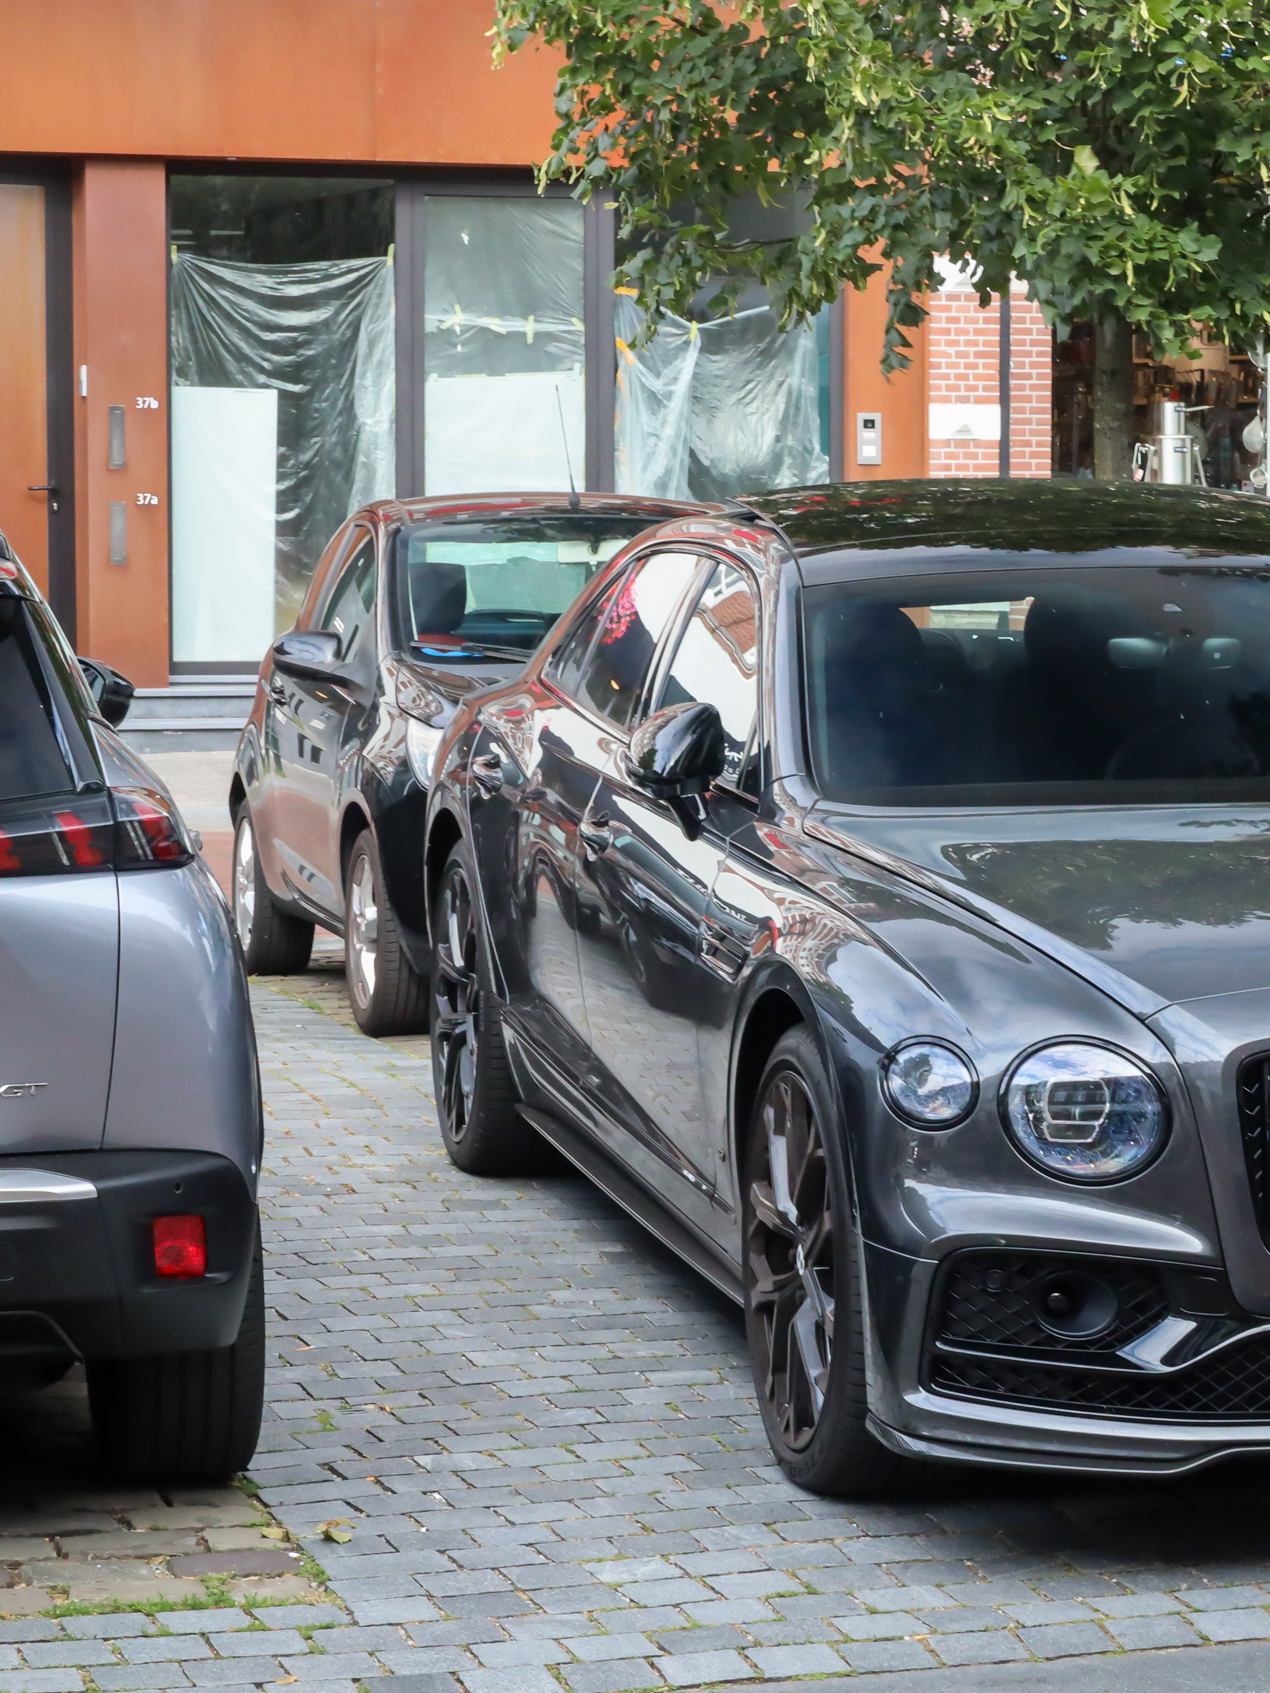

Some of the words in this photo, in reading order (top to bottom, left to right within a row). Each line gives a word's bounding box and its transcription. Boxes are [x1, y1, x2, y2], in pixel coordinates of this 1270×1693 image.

[135, 396, 160, 410] 37b
[136, 493, 159, 505] 37a
[0, 1082, 48, 1098] GT
